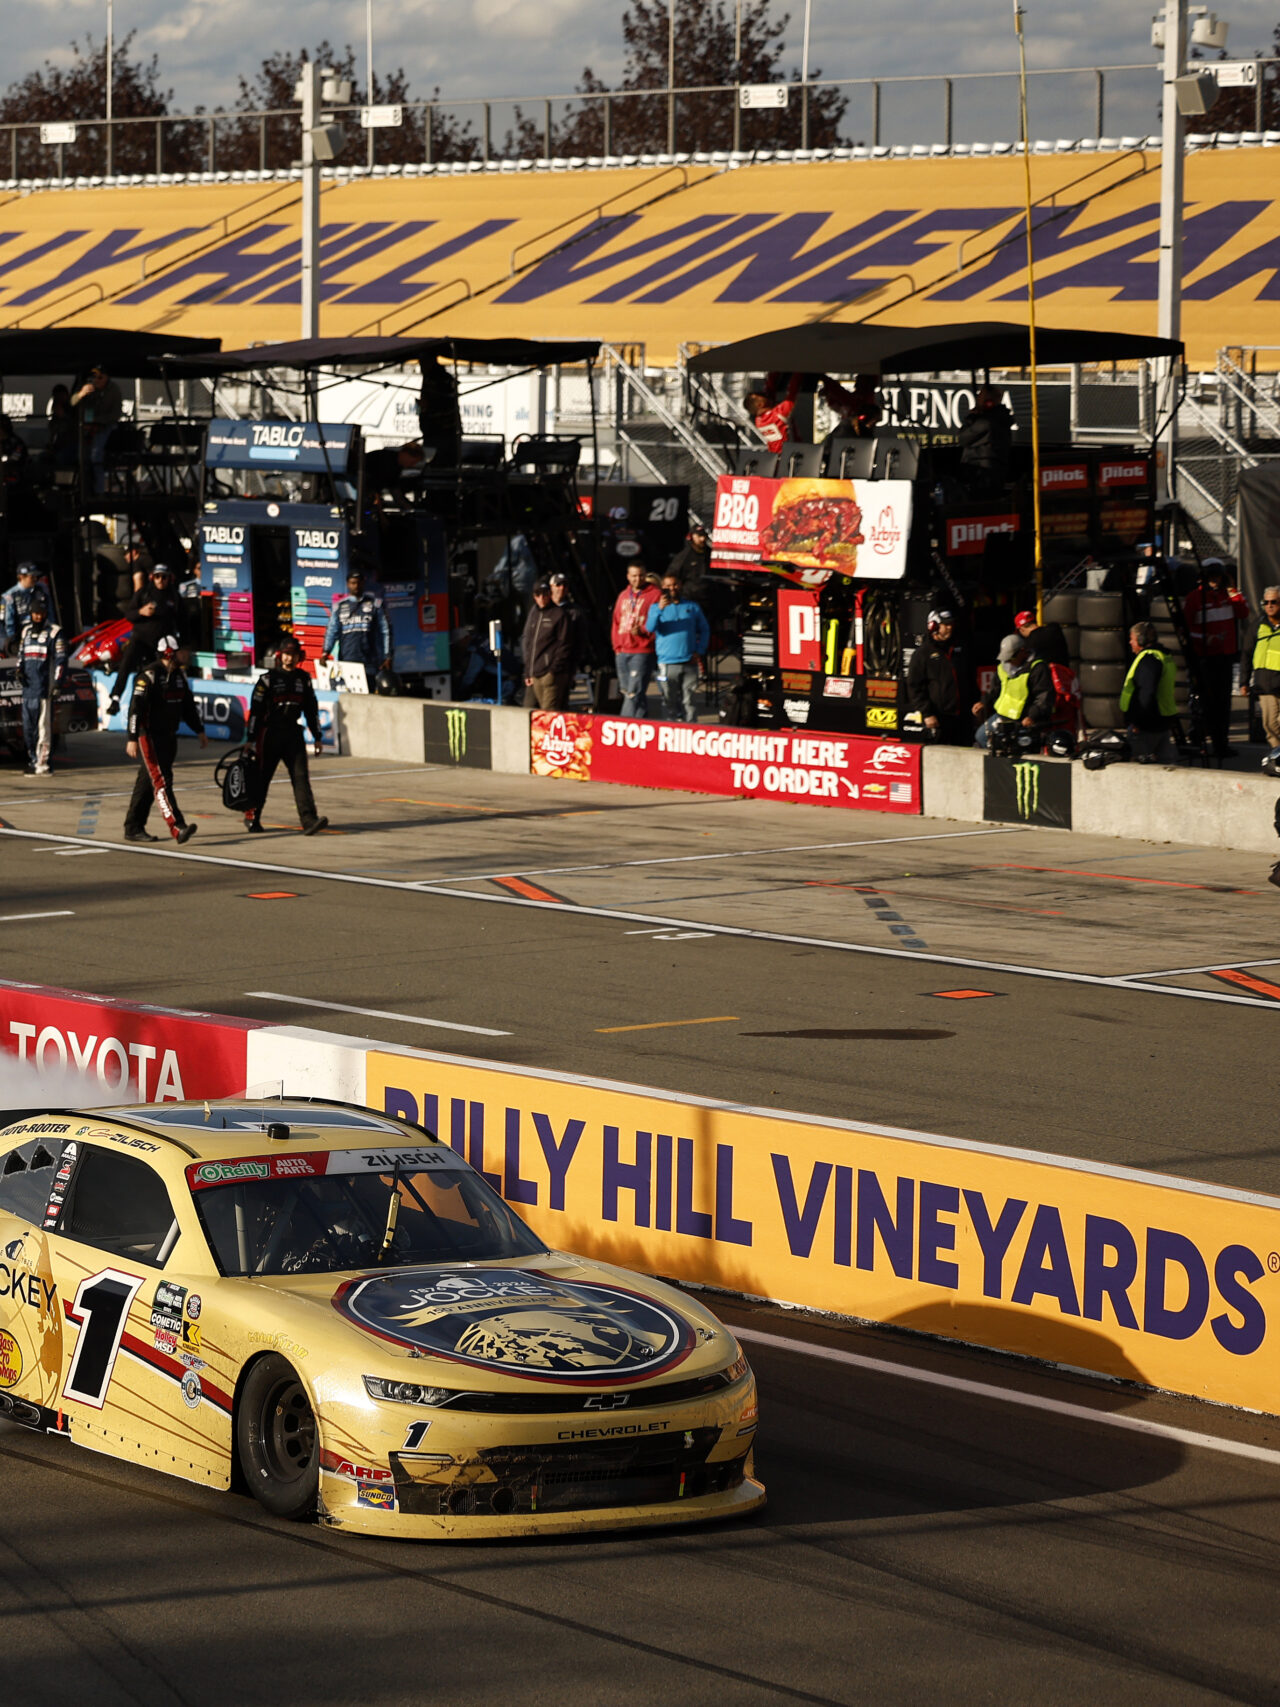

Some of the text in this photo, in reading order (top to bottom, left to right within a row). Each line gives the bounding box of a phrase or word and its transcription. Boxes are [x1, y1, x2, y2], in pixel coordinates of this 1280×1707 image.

[1241, 65, 1256, 82] 10
[112, 219, 519, 305] HILL
[252, 425, 305, 448] TABLO
[648, 497, 678, 521] 20
[716, 493, 759, 531] BBQ
[202, 526, 245, 544] TABLO
[295, 530, 340, 549] TABLO
[601, 720, 849, 769] STOP RIIIGGGHHHT HERE
[730, 762, 839, 797] TO ORDER
[9, 1021, 186, 1104] TOYOTA
[0, 1123, 71, 1138] ROTO-ROOTER
[110, 1133, 162, 1153] ZILISCH
[276, 1158, 307, 1168] AUTO
[362, 1152, 446, 1167] ZILISCH
[198, 1160, 270, 1183] O'Reilly
[275, 1165, 316, 1175] PARTS
[602, 1125, 754, 1249] HILL
[770, 1152, 1267, 1357] VINEYARDS
[151, 1313, 181, 1331] COMETIC
[62, 1267, 147, 1410] 1
[153, 1340, 175, 1355] MSD
[154, 1328, 178, 1348] Holley
[401, 1420, 433, 1450] 1
[557, 1421, 671, 1440] CHEVROLET
[337, 1462, 394, 1481] ARP
[359, 1489, 394, 1502] SUNOCO
